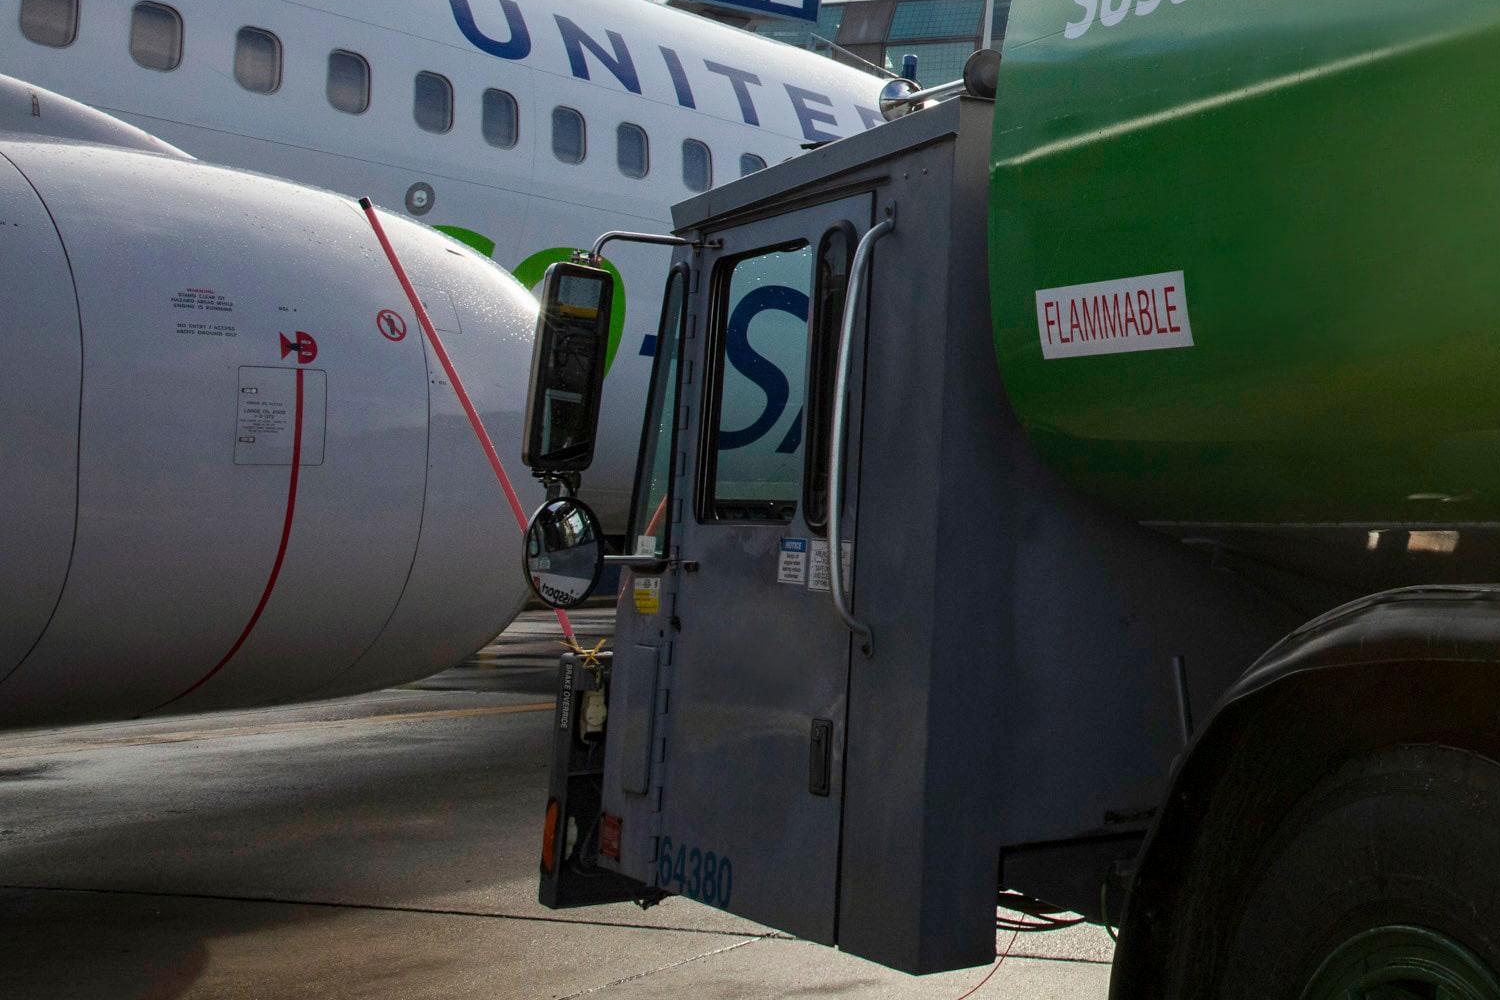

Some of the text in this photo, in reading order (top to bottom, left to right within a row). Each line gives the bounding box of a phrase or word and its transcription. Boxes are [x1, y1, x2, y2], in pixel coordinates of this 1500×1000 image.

[1044, 285, 1181, 345] FLAMMABLE
[560, 663, 573, 729] BRAKE OVERRIDE
[658, 836, 733, 908] 64380
